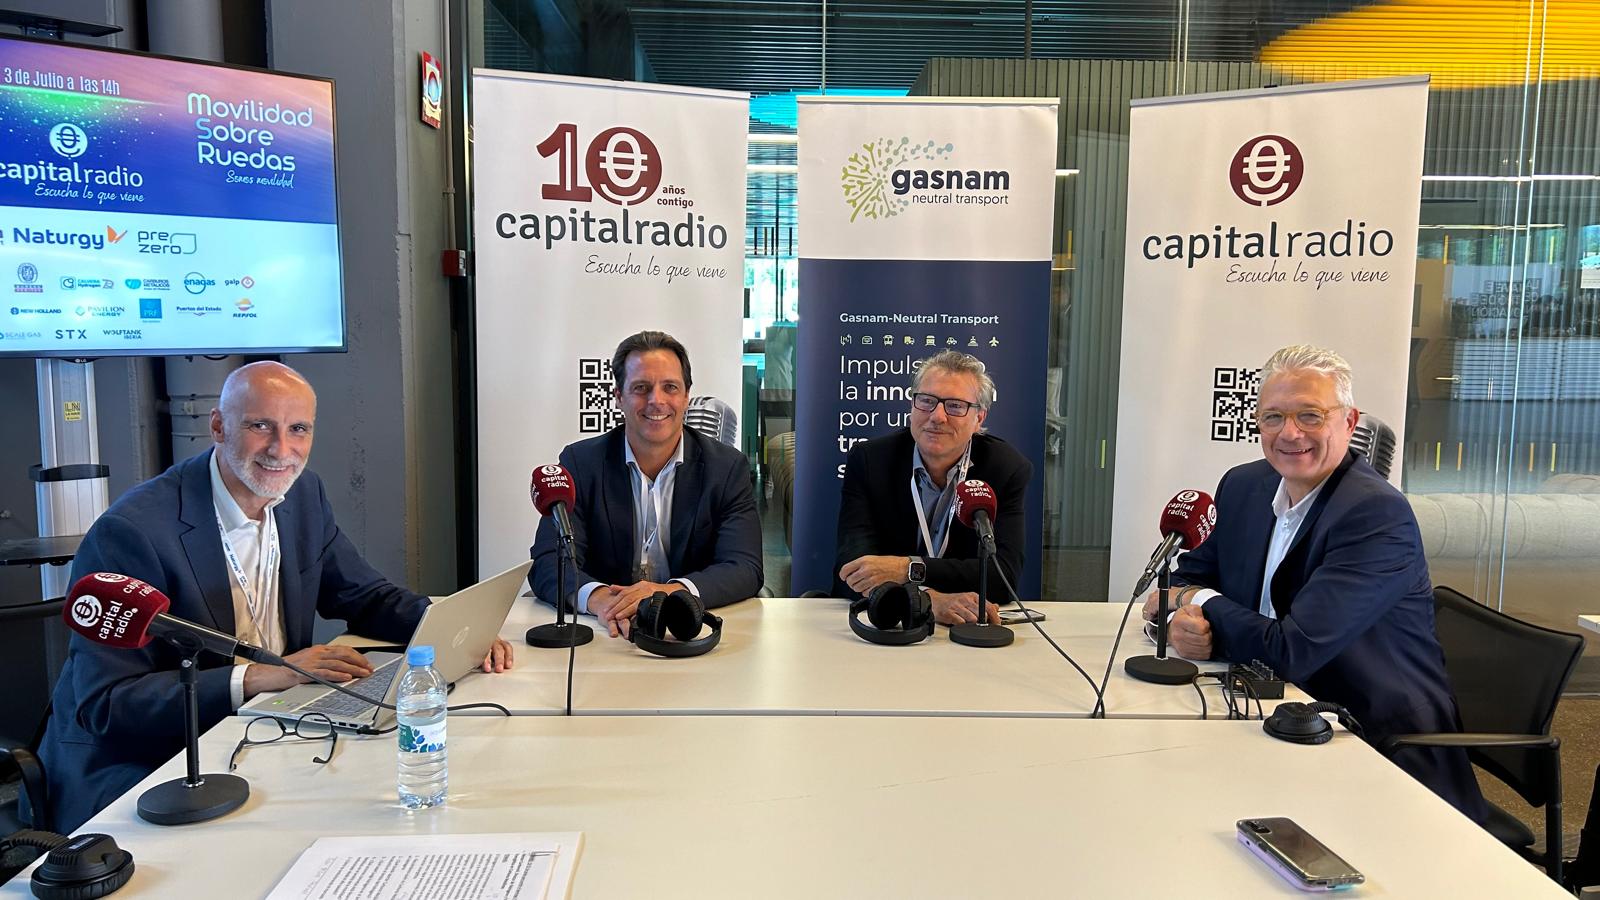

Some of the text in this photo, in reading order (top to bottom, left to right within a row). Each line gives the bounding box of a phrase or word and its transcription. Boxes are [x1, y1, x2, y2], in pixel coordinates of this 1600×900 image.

[4, 67, 120, 96] 3 de Julio a las 14h
[187, 92, 313, 127] Movilidad
[195, 118, 274, 146] Sobre
[197, 141, 296, 171] Ruedas
[34, 182, 144, 204] Escucha lo que viene
[662, 185, 686, 195] años
[891, 169, 1010, 195] gasnam
[656, 197, 694, 208] contigo
[912, 193, 1009, 206] neutral transport
[13, 227, 104, 249] Naturgy
[137, 229, 169, 243] pre
[495, 207, 728, 250] capitalradio
[139, 243, 182, 255] zero
[585, 253, 728, 284] Escucha lo que viene
[1226, 260, 1391, 290] Escucha lo que viene
[840, 312, 1000, 326] Gasnam-Neutral Transport
[55, 329, 87, 339] STX
[839, 381, 858, 400] la
[839, 412, 880, 430] por
[1168, 502, 1194, 511] capital
[99, 600, 123, 640] capital
